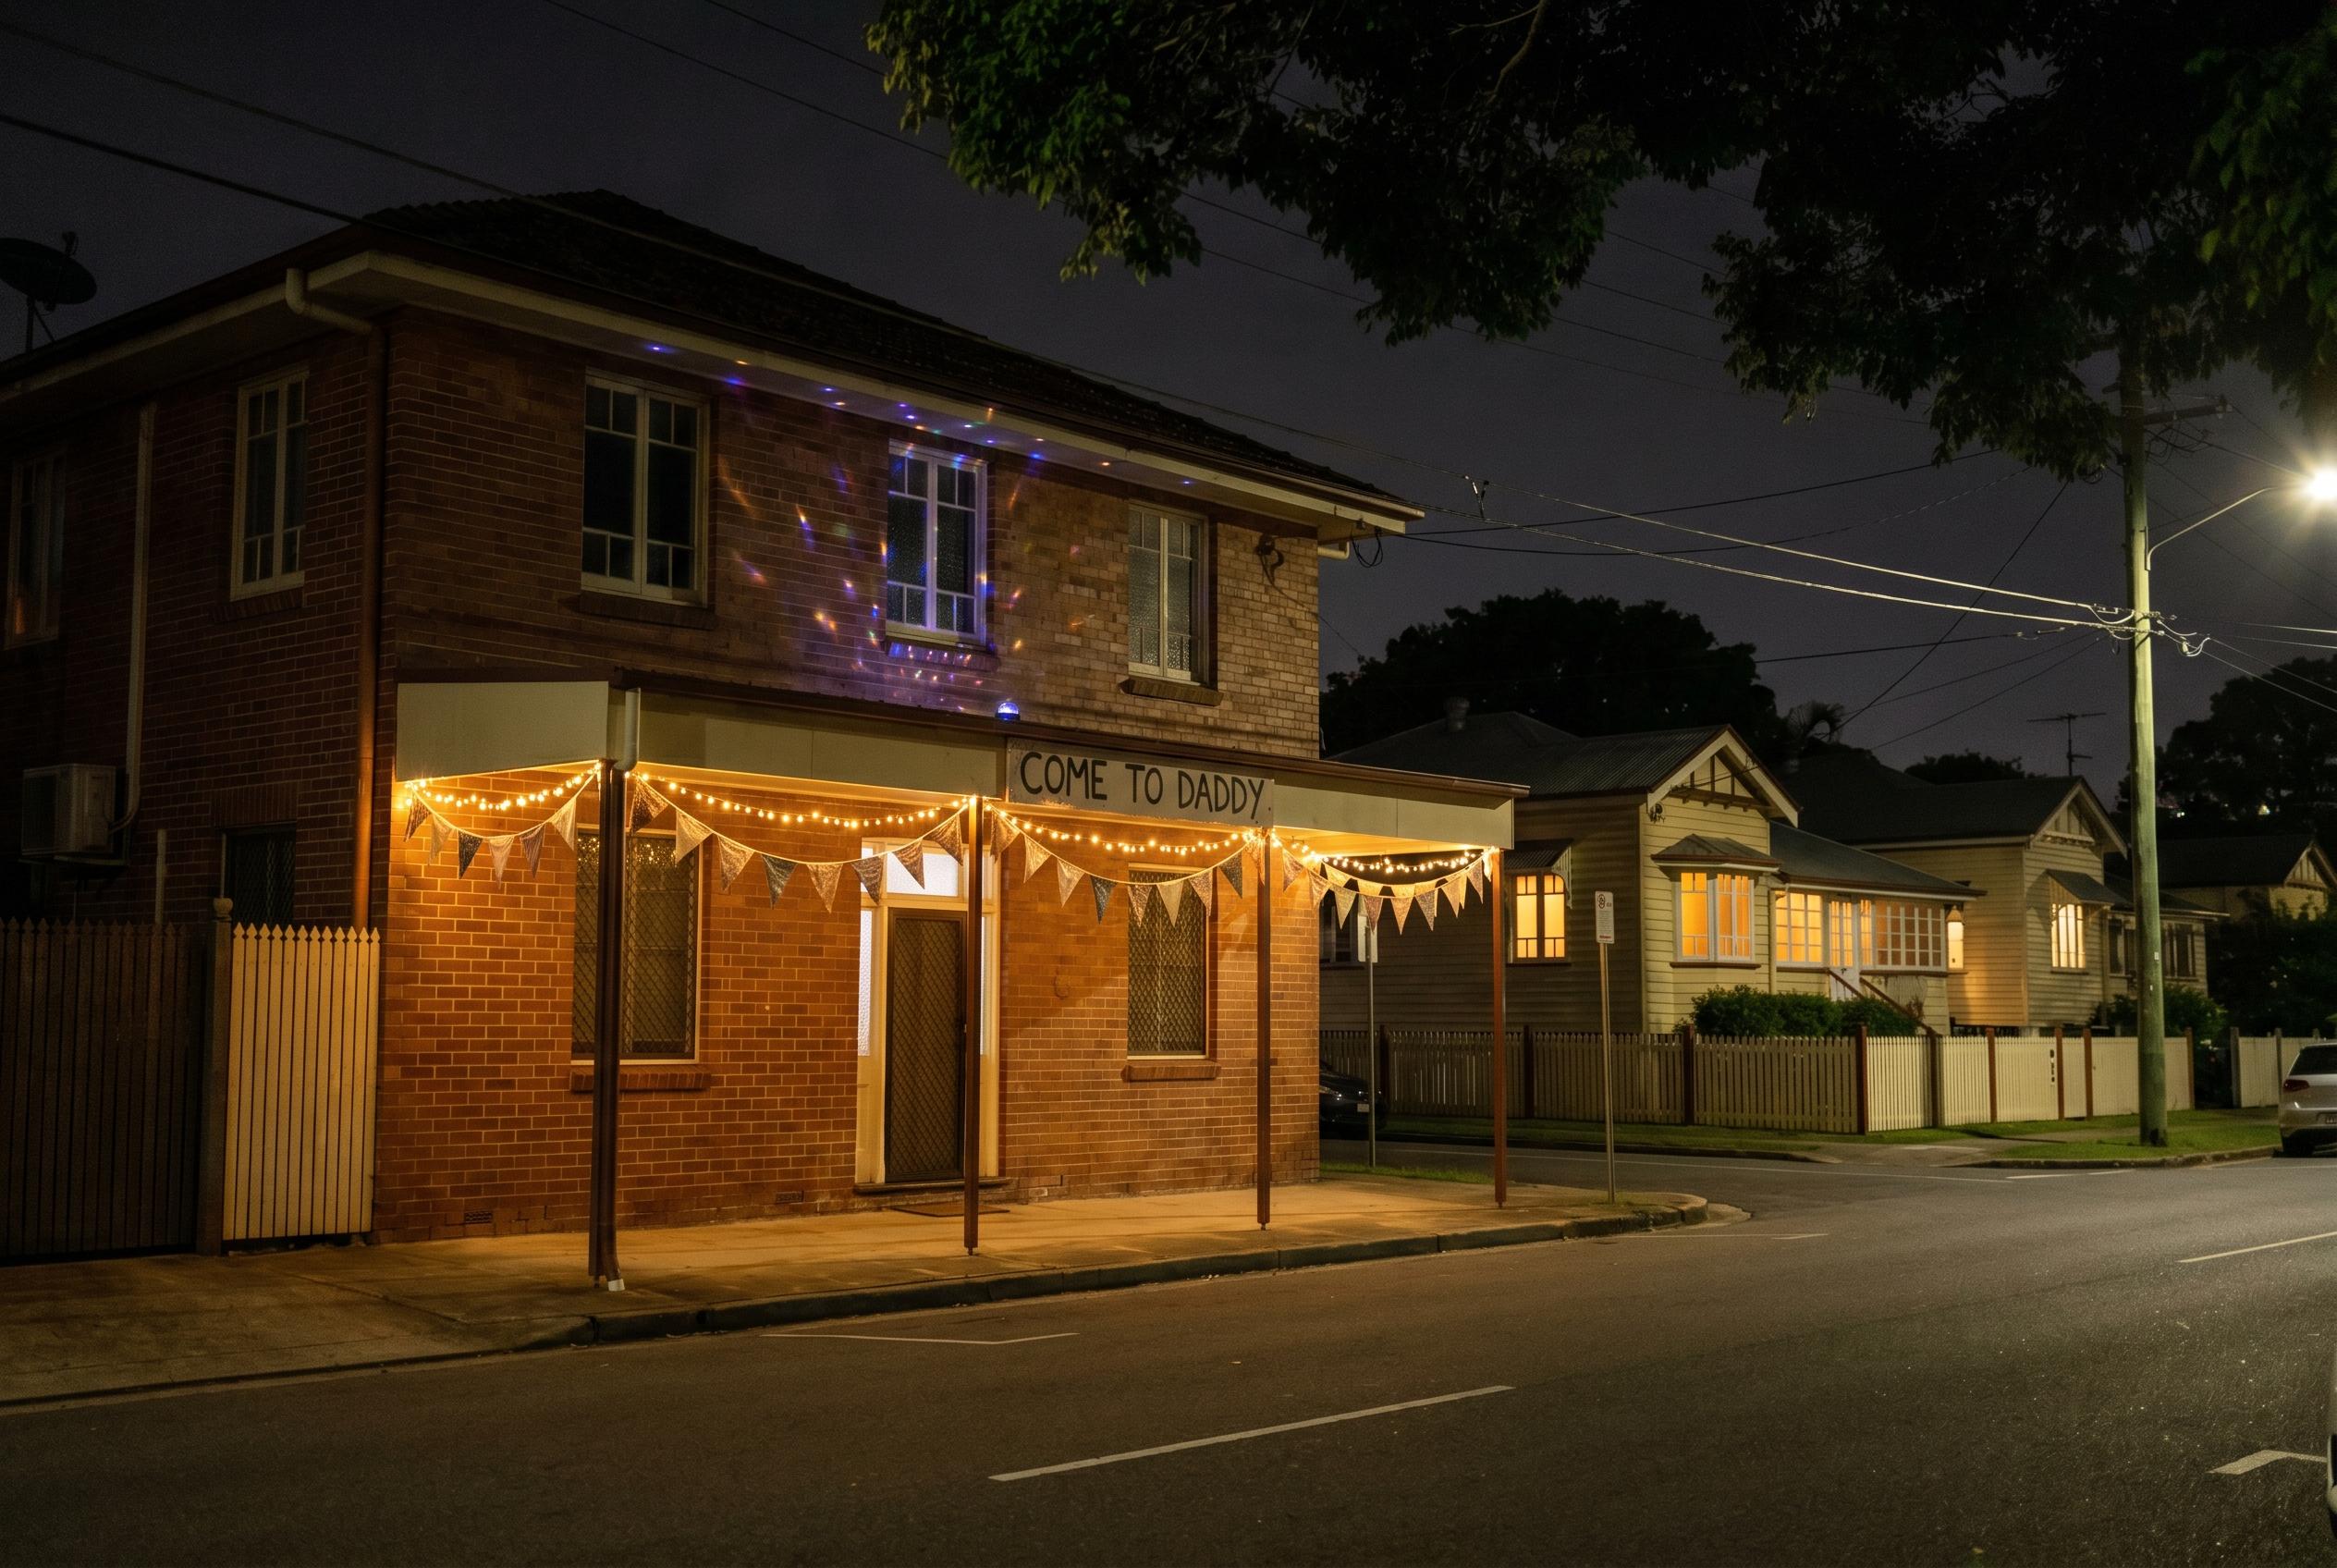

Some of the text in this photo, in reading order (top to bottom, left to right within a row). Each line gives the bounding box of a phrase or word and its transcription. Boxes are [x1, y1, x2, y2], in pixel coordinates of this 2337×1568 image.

[1021, 752, 1265, 819] COME TO DADDY
